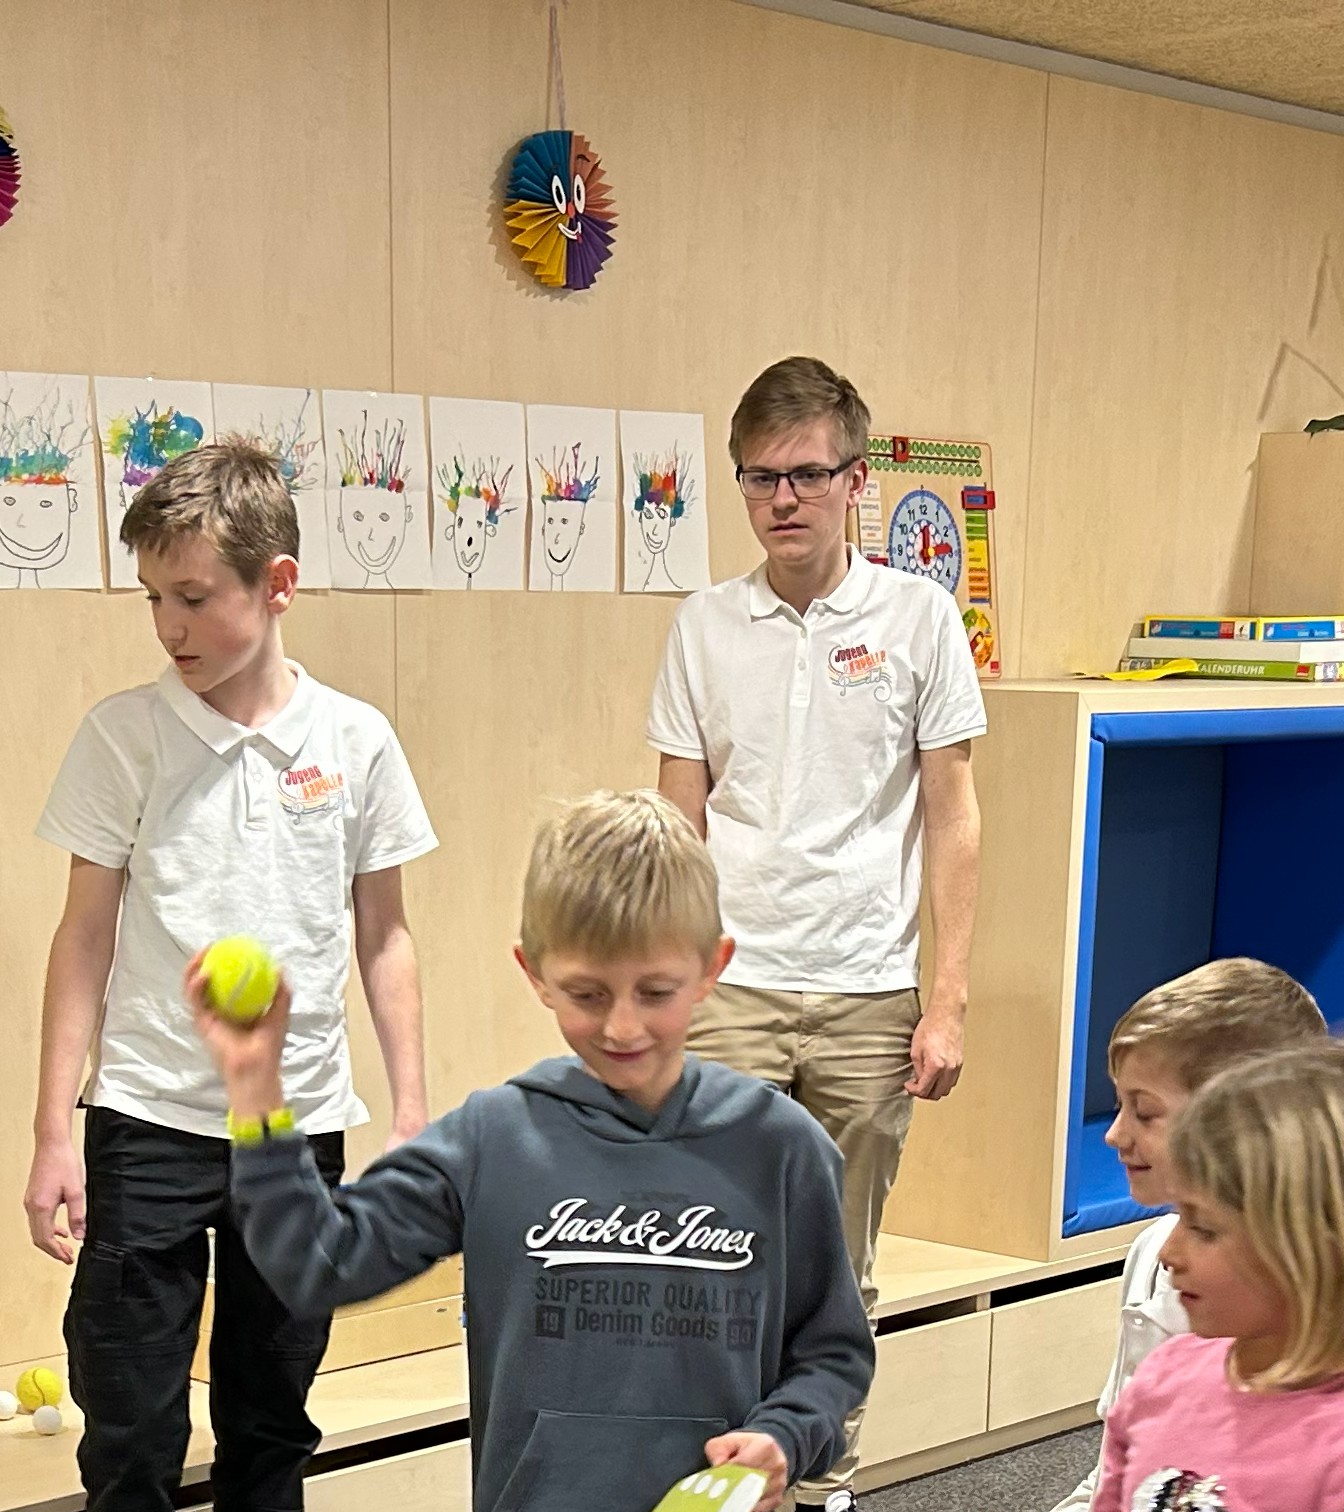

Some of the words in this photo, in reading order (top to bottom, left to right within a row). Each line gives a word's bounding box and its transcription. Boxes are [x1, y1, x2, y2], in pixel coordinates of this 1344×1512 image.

[907, 508, 916, 520] 11
[919, 504, 928, 515] 12
[899, 523, 908, 535] 10
[943, 526, 949, 538] 2
[897, 544, 903, 556] 9
[945, 567, 951, 579] 4
[535, 1276, 651, 1307] SUPERIOR
[664, 1284, 762, 1317] QUALITY
[575, 1307, 643, 1335] Denim
[651, 1311, 719, 1341] Goods
